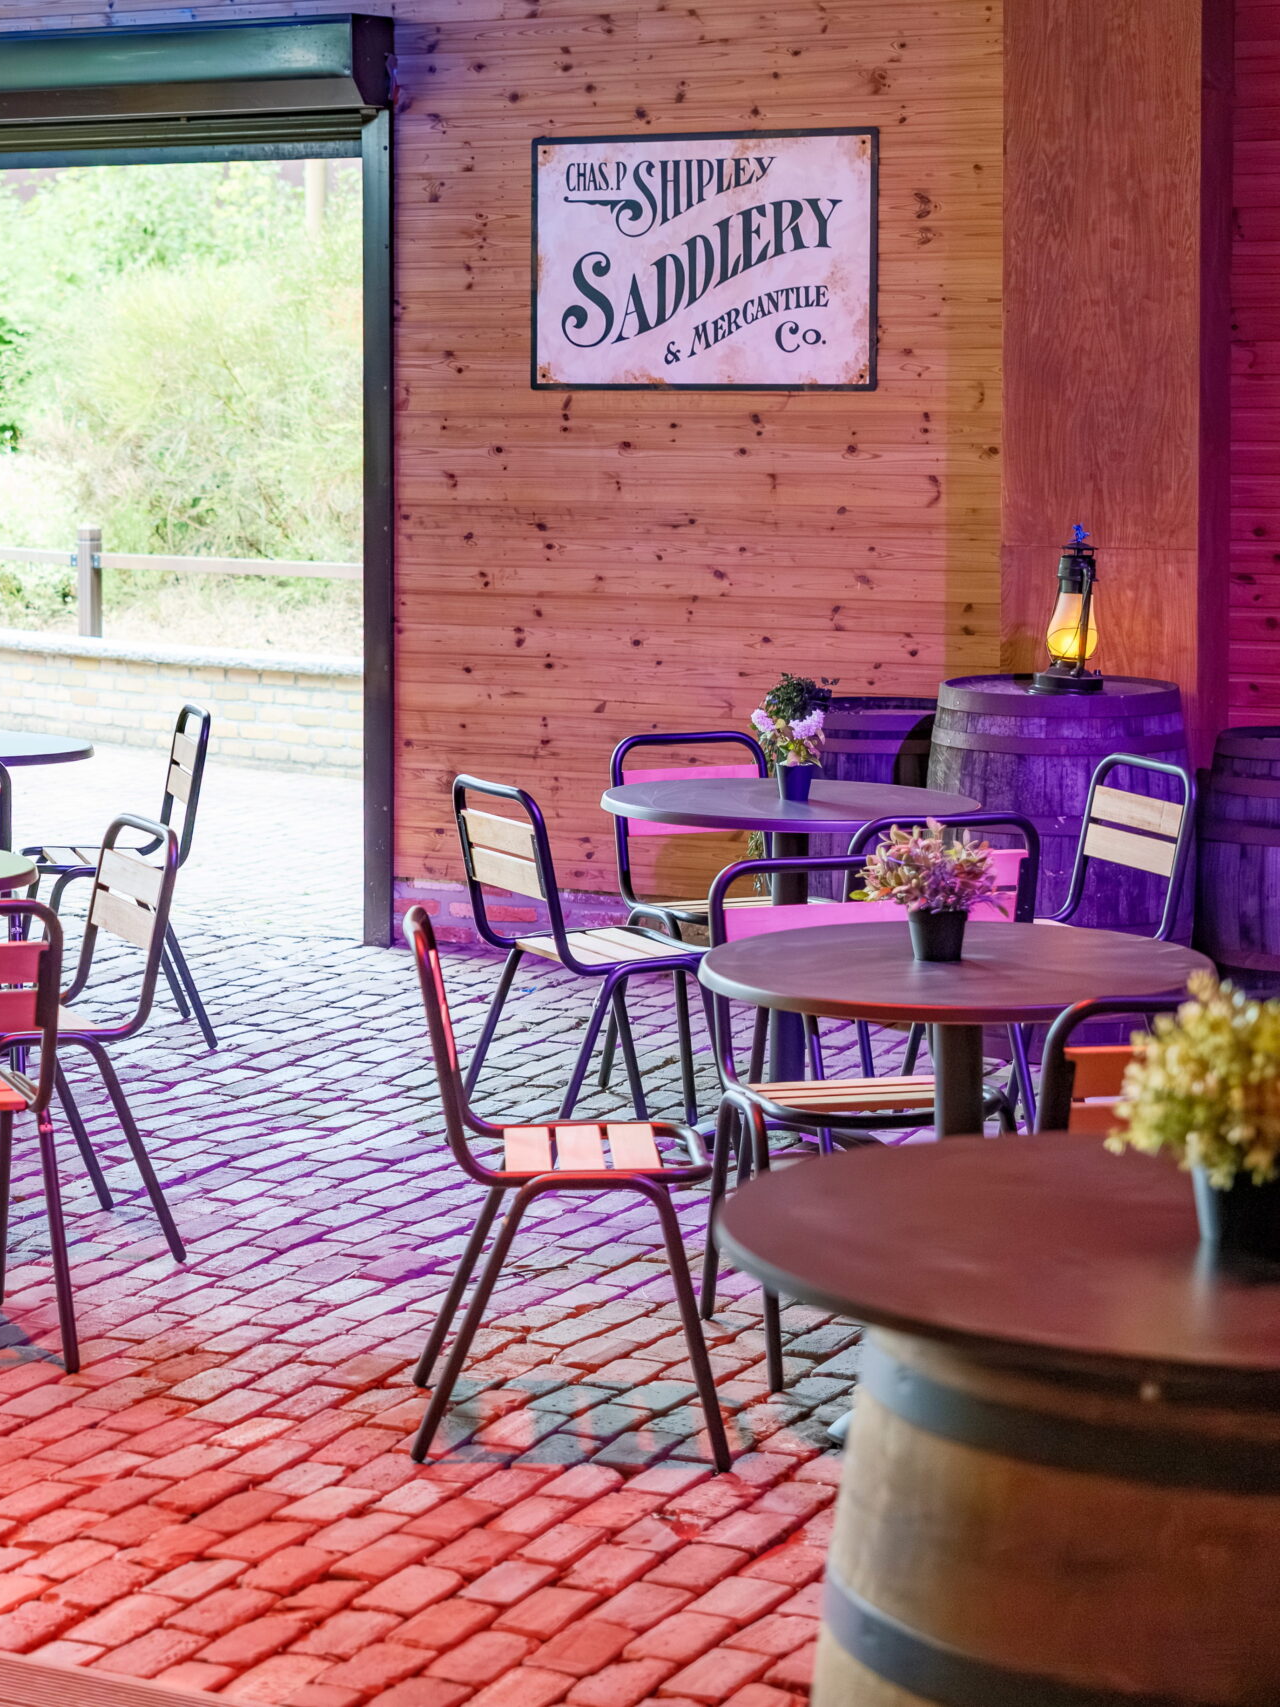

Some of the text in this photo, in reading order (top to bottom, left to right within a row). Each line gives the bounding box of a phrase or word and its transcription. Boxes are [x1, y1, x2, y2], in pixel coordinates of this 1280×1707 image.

[615, 156, 777, 238] SHIPLEY
[561, 198, 843, 348] SADDLERY
[663, 284, 830, 365] & MERCANTILE
